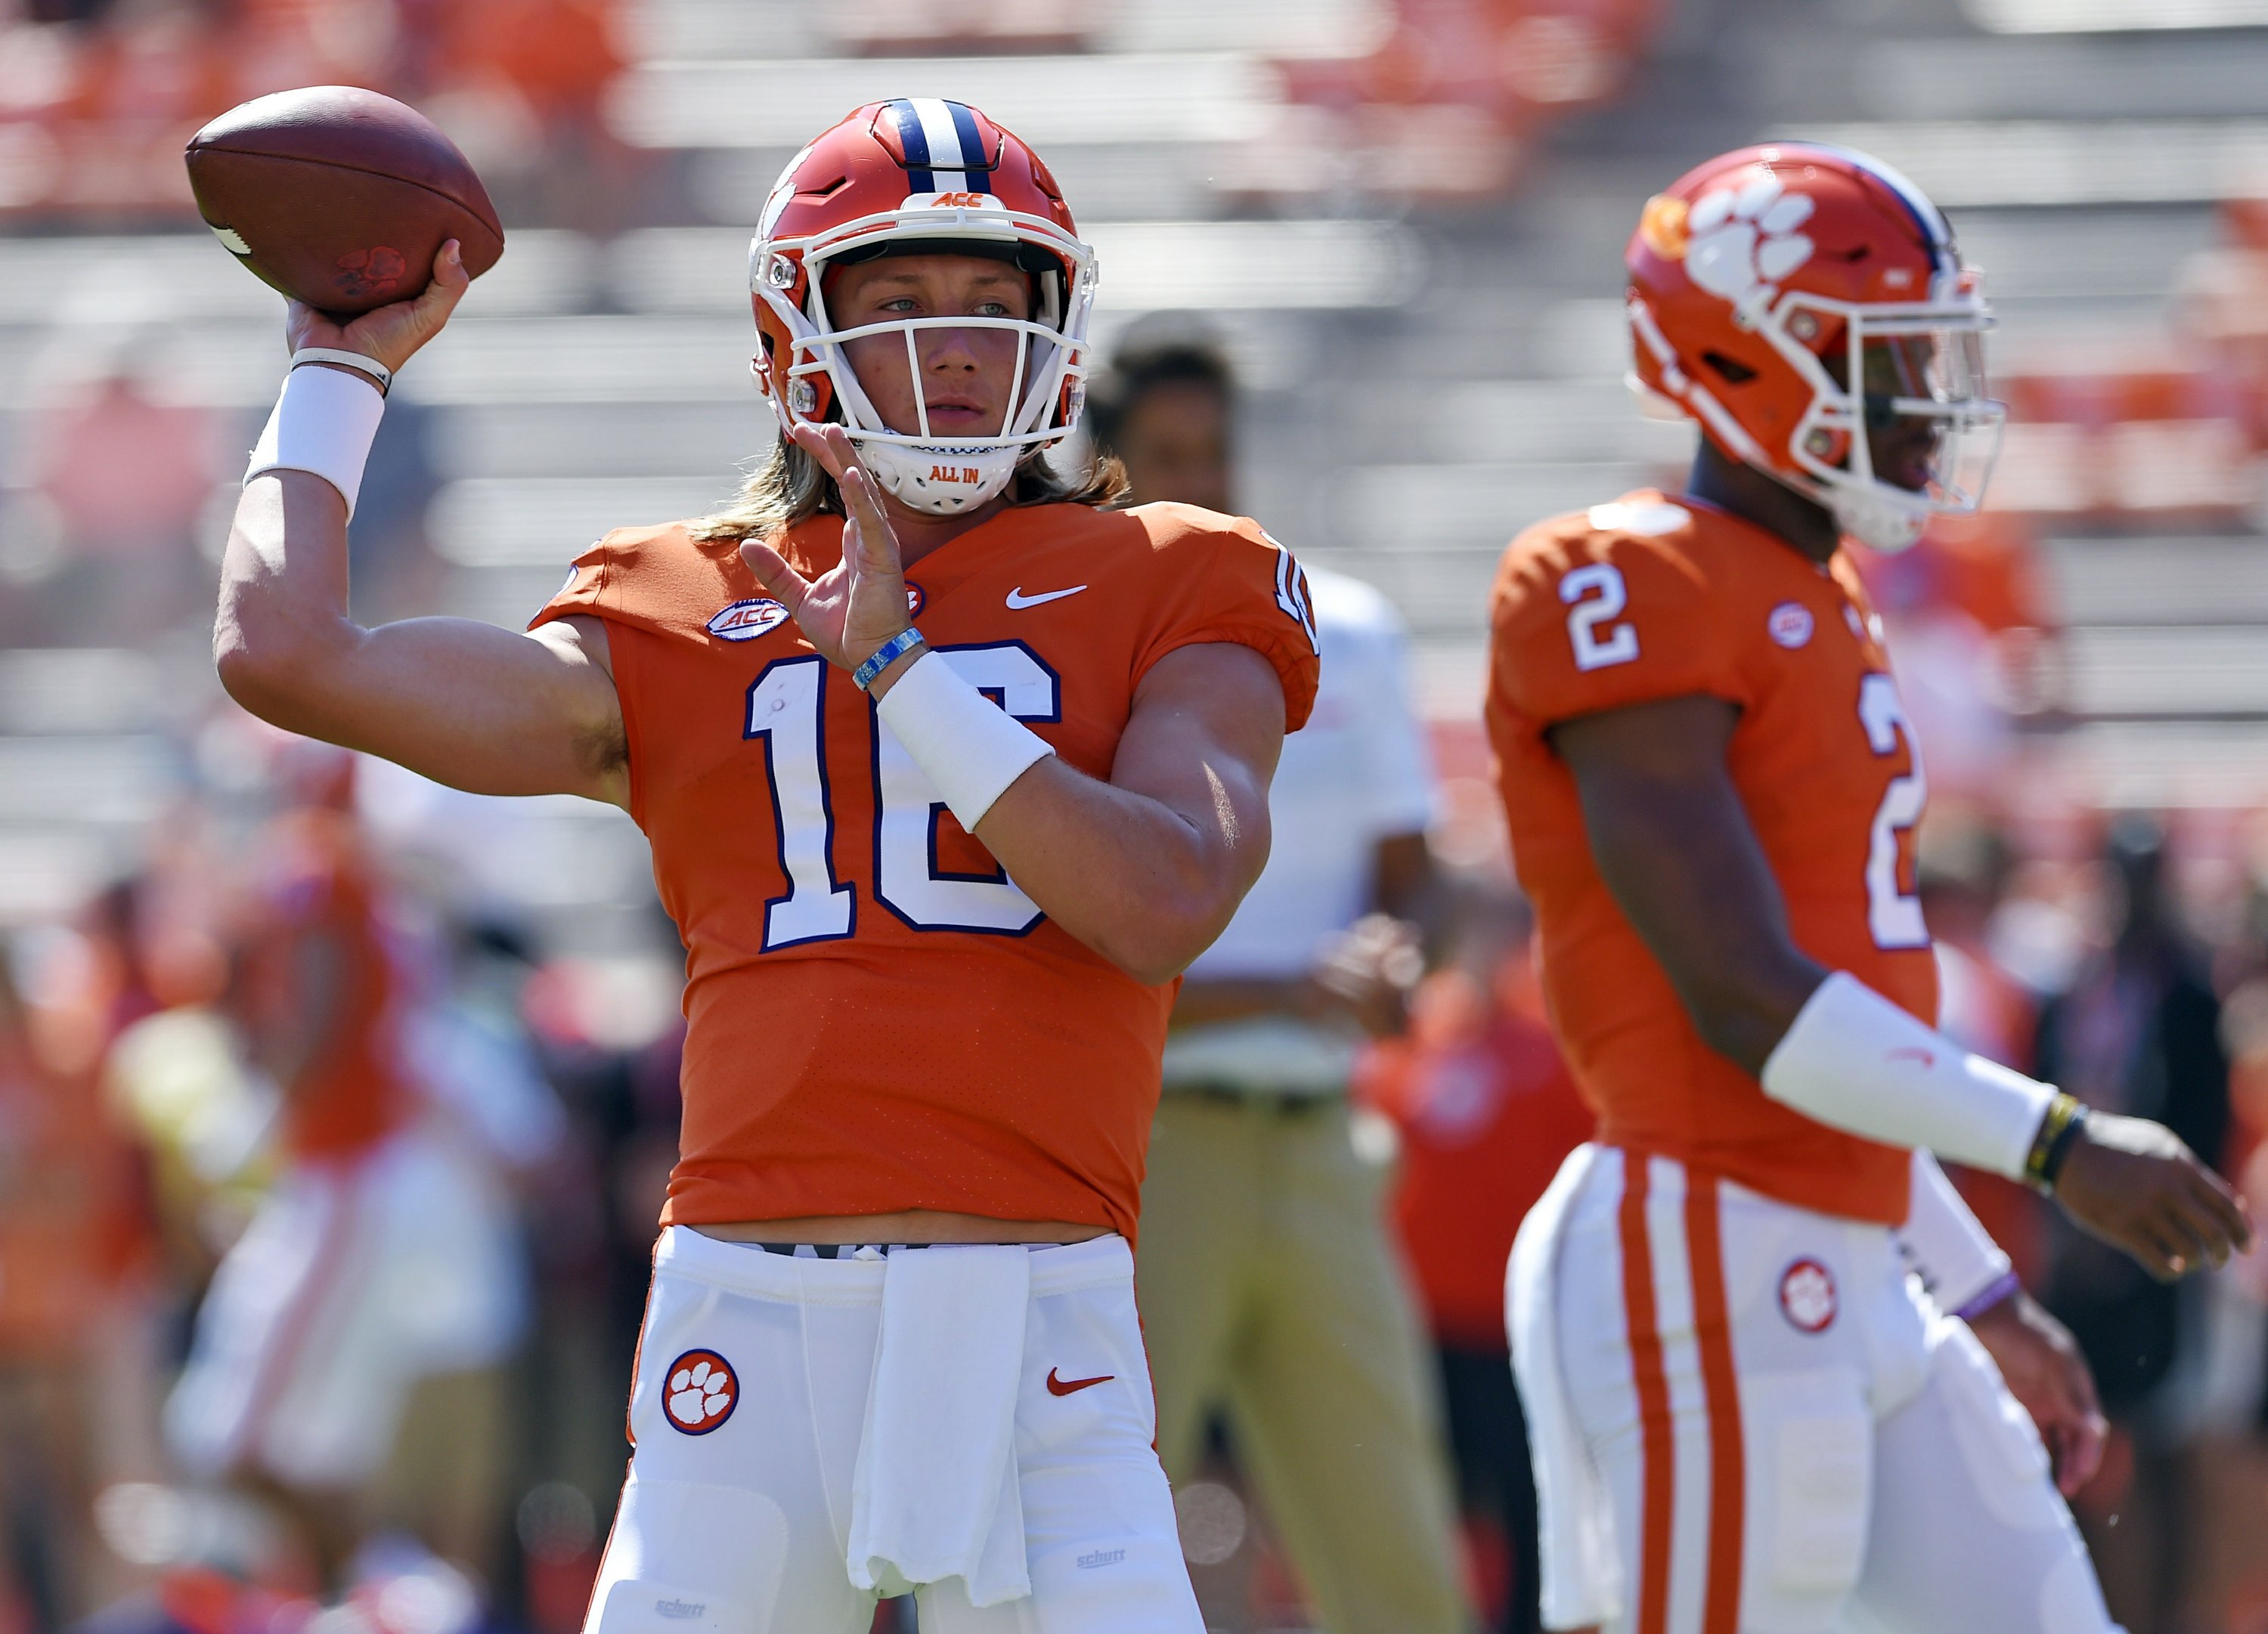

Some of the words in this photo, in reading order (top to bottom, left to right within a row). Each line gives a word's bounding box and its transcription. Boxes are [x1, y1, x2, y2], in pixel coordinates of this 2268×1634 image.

[931, 192, 984, 208] ACC
[929, 466, 959, 482] ALL
[963, 468, 979, 484] IN
[718, 605, 779, 629] ACC
[1558, 561, 1641, 672] 2
[742, 639, 1061, 954] 16
[1077, 1549, 1126, 1567] schutt
